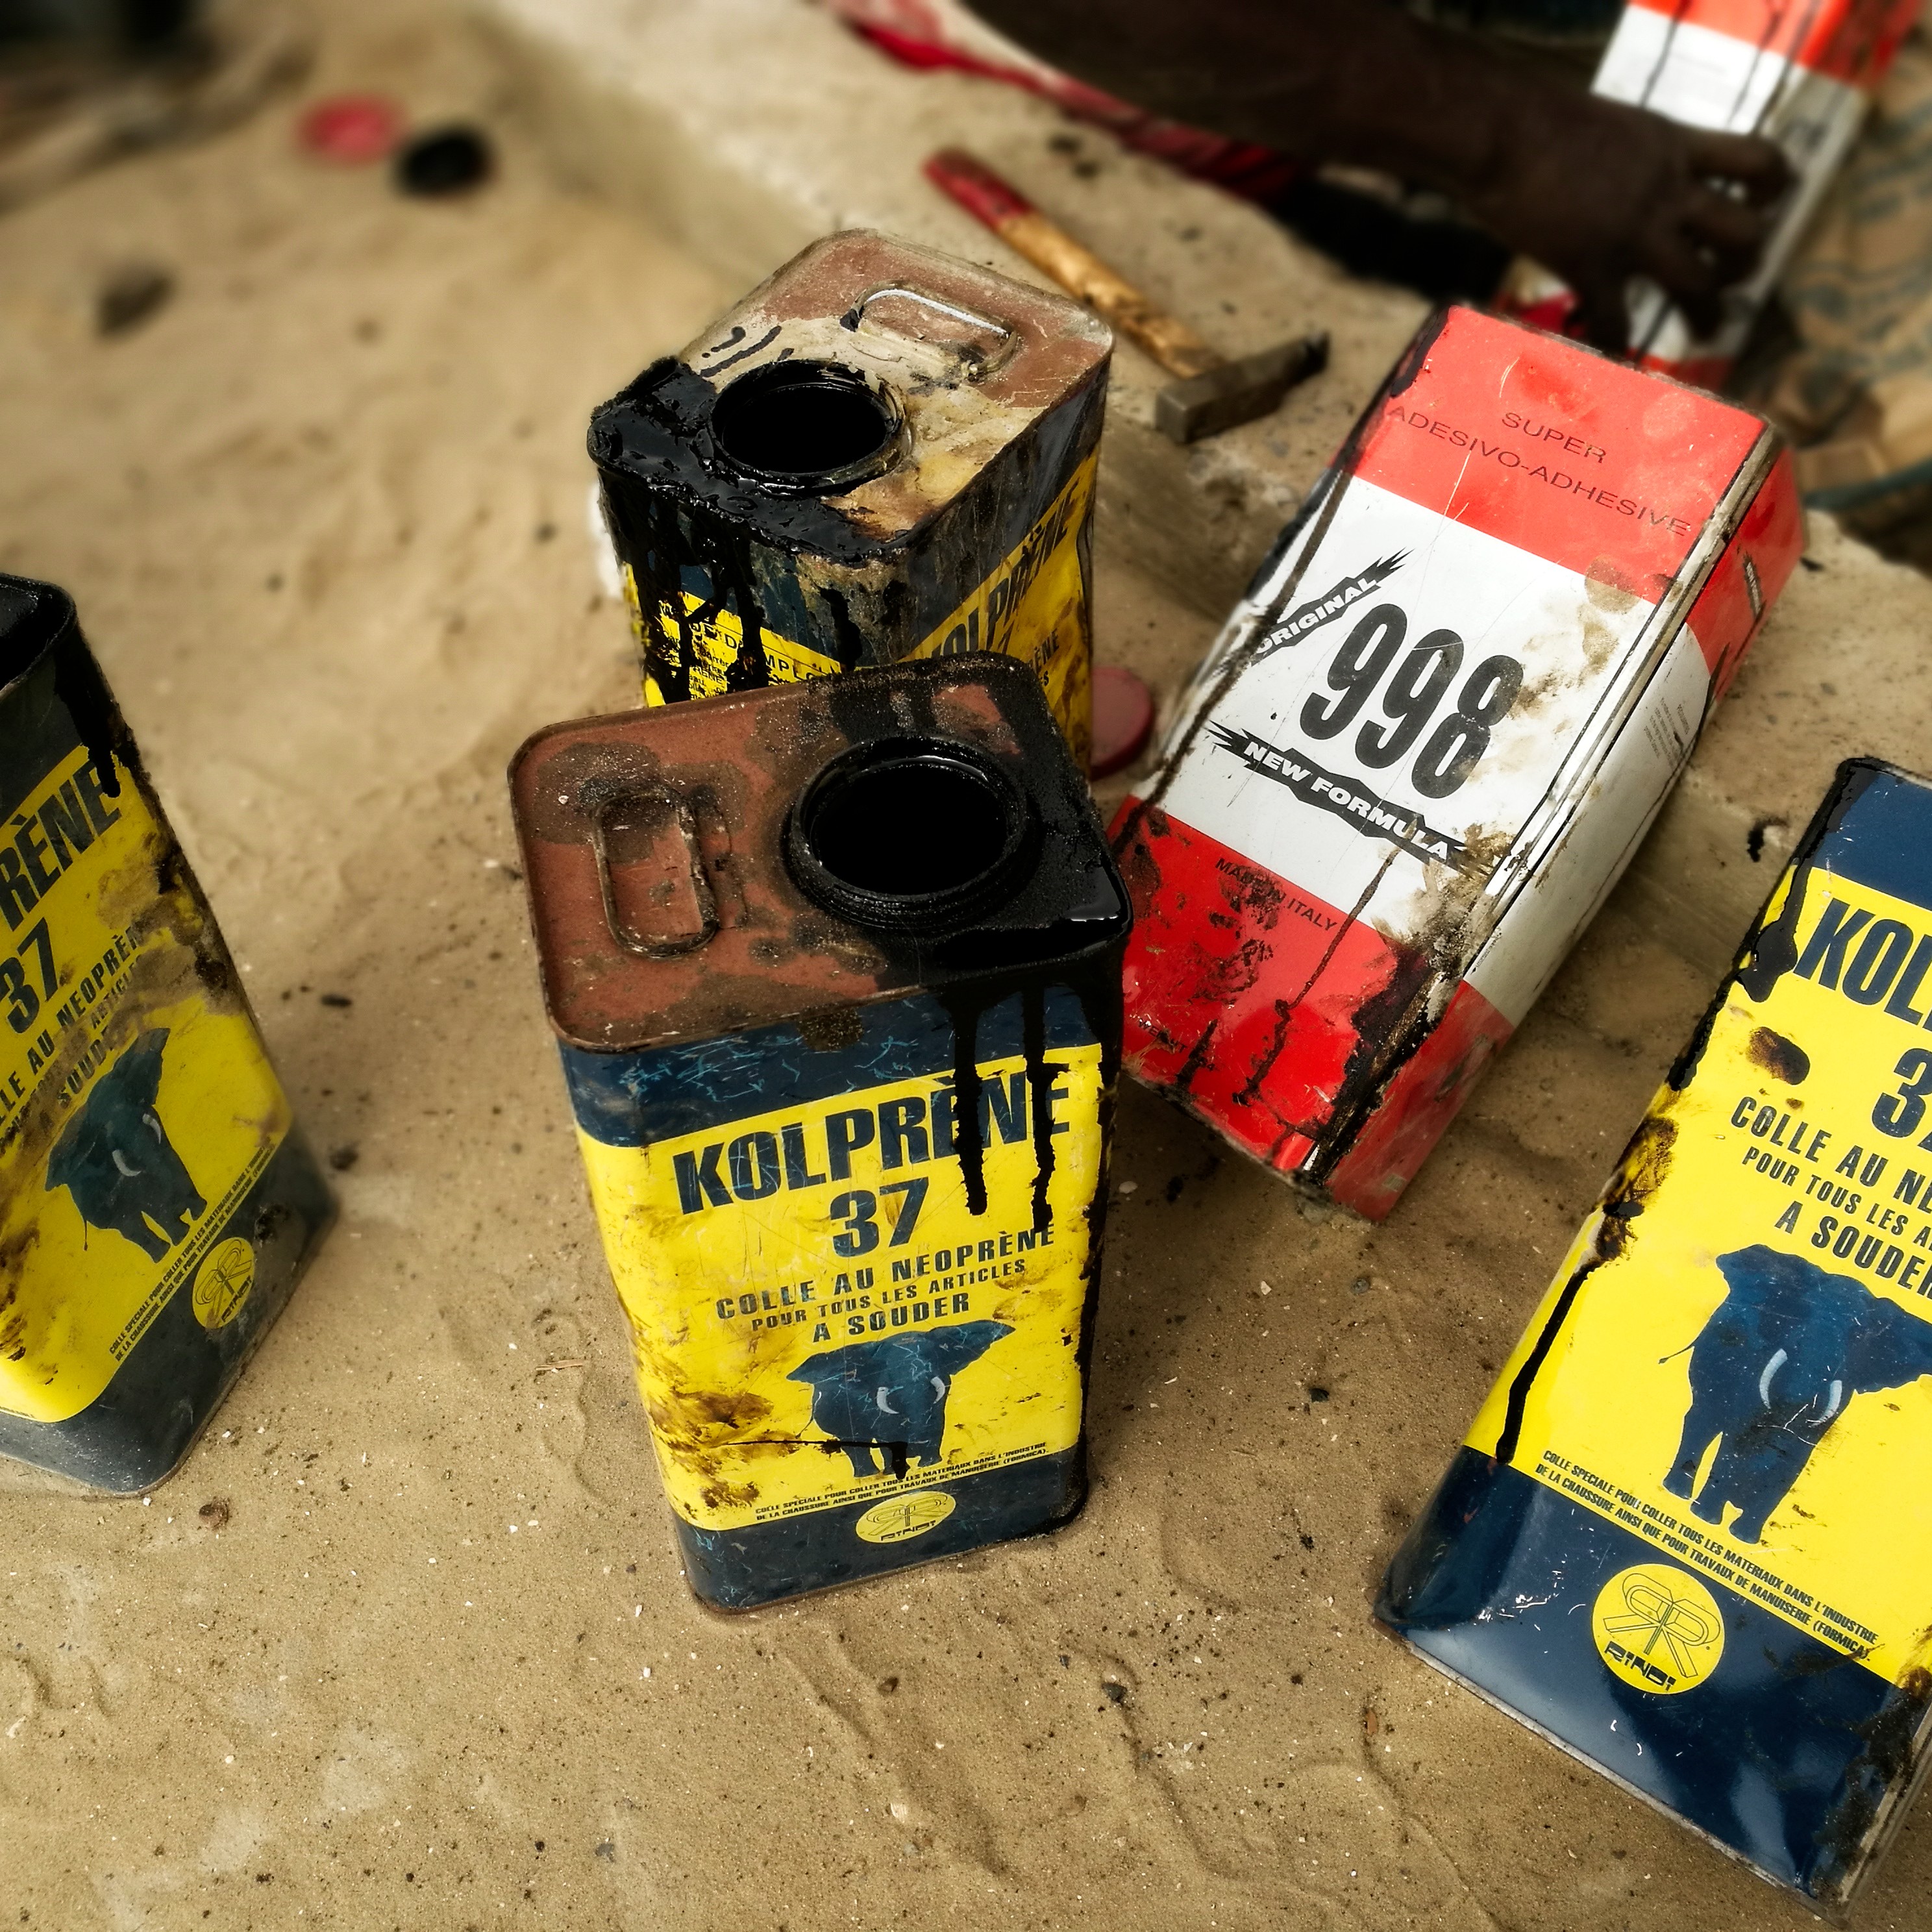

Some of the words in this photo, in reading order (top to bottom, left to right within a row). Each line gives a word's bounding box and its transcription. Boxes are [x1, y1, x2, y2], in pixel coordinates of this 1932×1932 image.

[1387, 406, 1690, 536] ADESIVO-ADHESIVE
[1502, 412, 1606, 463] SUPER
[1300, 603, 1524, 799] 998
[1243, 741, 1312, 782] NEW
[1310, 776, 1448, 860] FORMULA
[1287, 898, 1337, 931] ITALY
[0, 917, 59, 1034] 37
[1793, 897, 1932, 1032] KOL
[27, 1029, 56, 1076] AU
[1731, 1096, 1832, 1163] COLLE
[1835, 1145, 1889, 1187] AU
[1871, 1048, 1932, 1153] 3
[828, 1176, 930, 1258] 37
[1742, 1146, 1800, 1187] POUR
[1805, 1174, 1861, 1214] TOUS
[1866, 1203, 1909, 1235] LES
[1774, 1200, 1803, 1234] A
[715, 1280, 816, 1319] COLLE
[834, 1267, 874, 1296] AU
[892, 1224, 1054, 1283] NEOPRÈNE
[752, 1309, 807, 1331] POUR
[817, 1295, 871, 1318] TOUS
[882, 1285, 917, 1304] LES
[928, 1259, 1025, 1294] ARTICLES
[813, 1322, 831, 1343] A
[848, 1293, 969, 1335] SOUDER
[1535, 1463, 1548, 1477] DE
[1548, 1470, 1559, 1484] LA
[1561, 1478, 1615, 1513] CHAUSSURE
[1615, 1507, 1643, 1529] AINSI
[1642, 1522, 1663, 1540] QUE
[1662, 1533, 1689, 1555] POUR
[1689, 1548, 1736, 1582] TRAVAUX
[1735, 1574, 1750, 1590] DE
[1750, 1582, 1813, 1626] MANUISERIE
[1543, 1450, 1572, 1471] COLLE
[1572, 1465, 1615, 1496] SPECIALE
[1615, 1488, 1642, 1509] POUR
[1642, 1504, 1678, 1530] COLLER
[1678, 1523, 1705, 1544] TOUS
[1704, 1538, 1724, 1555] LES
[1724, 1549, 1784, 1591] MATERIAUX
[1785, 1583, 1814, 1608] DANS
[1814, 1600, 1879, 1644] L'INDUSTRIE
